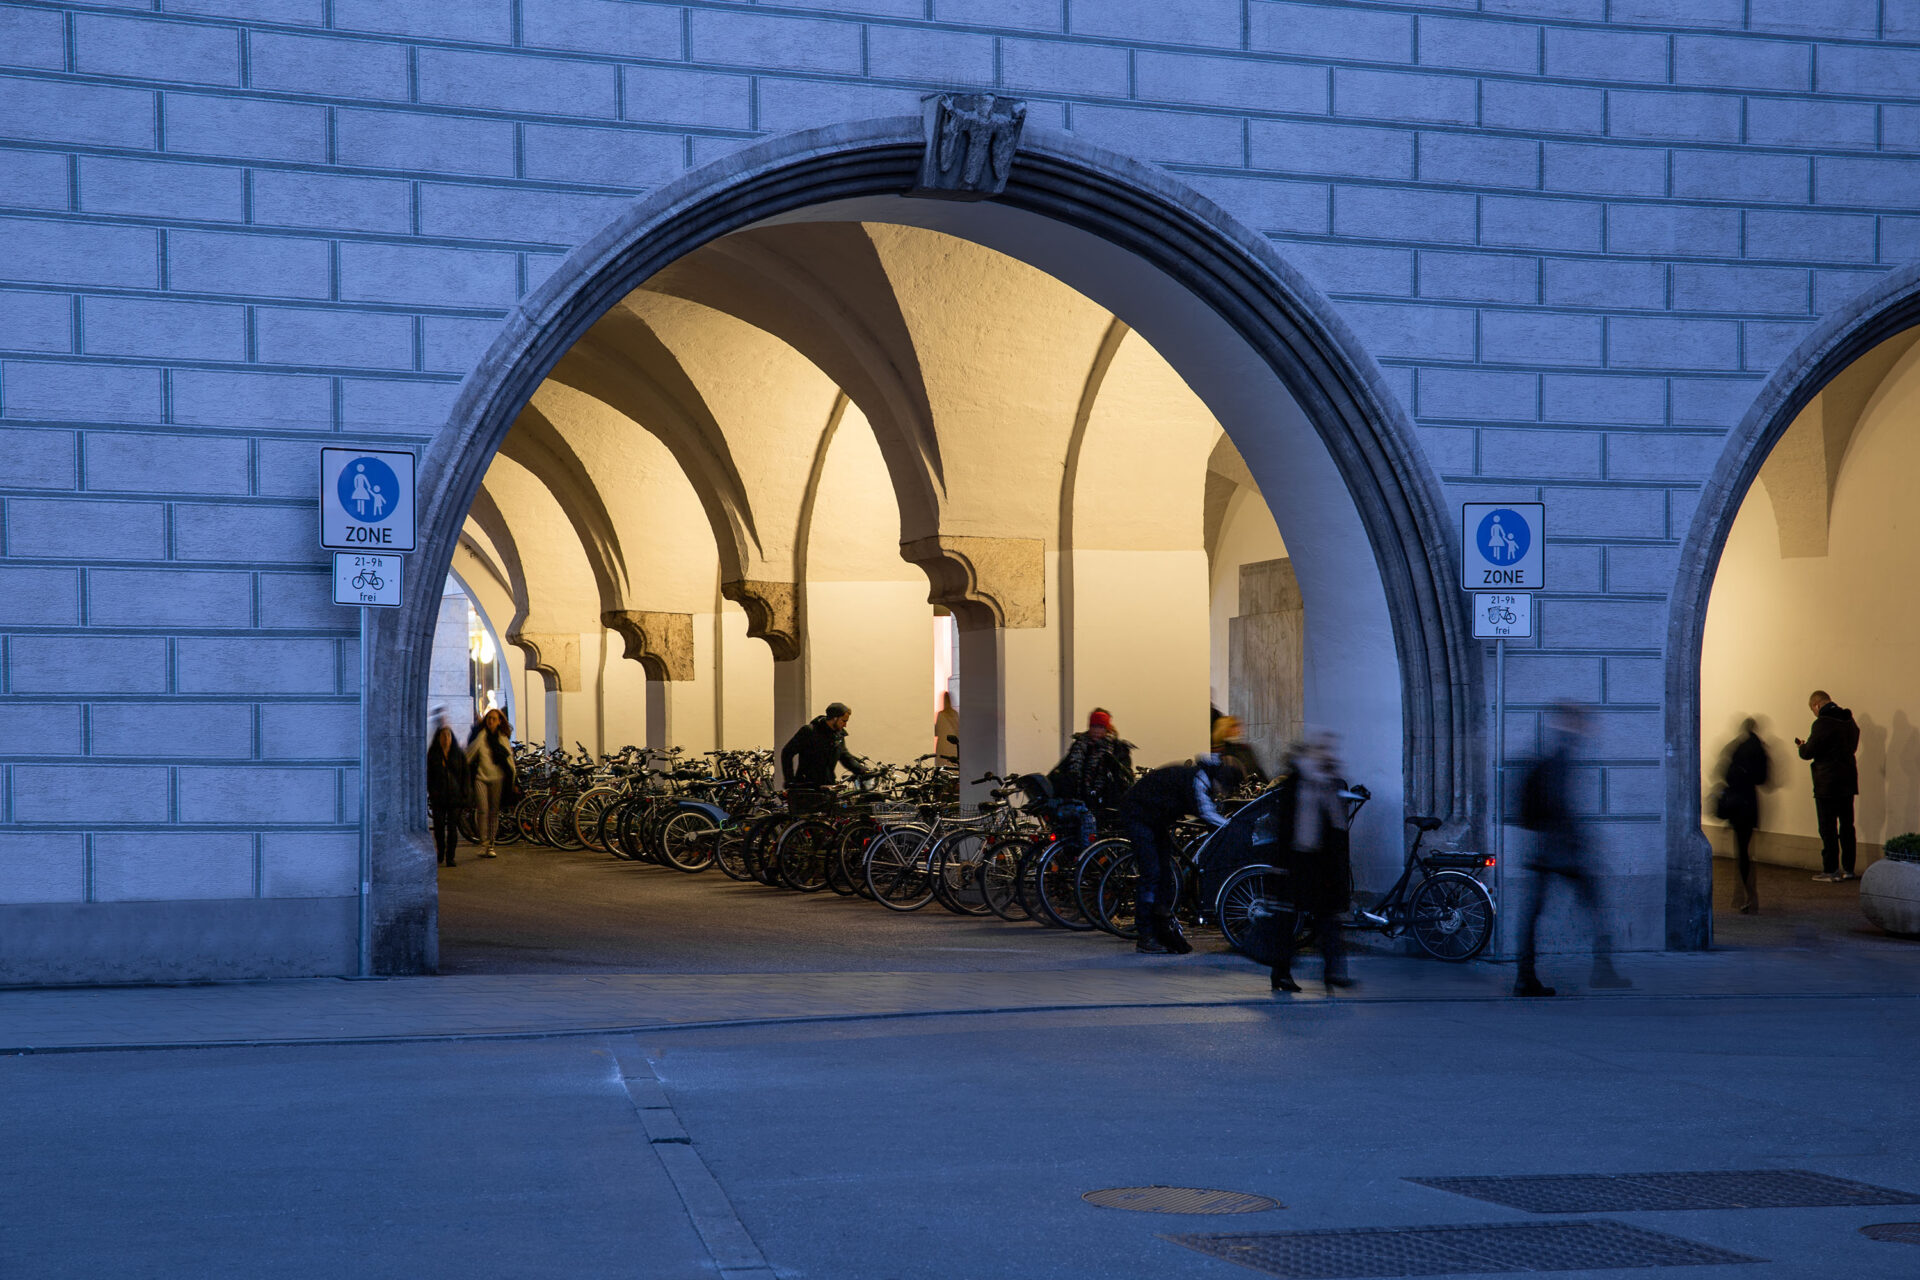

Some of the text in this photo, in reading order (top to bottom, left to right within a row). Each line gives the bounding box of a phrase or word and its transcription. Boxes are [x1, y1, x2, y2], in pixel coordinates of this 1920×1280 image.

[345, 526, 392, 543] ZONE
[354, 557, 382, 567] 21-9h
[1483, 570, 1524, 584] ZONE
[359, 592, 376, 602] frei
[1491, 595, 1515, 604] 21-9h
[1495, 626, 1510, 634] frei
